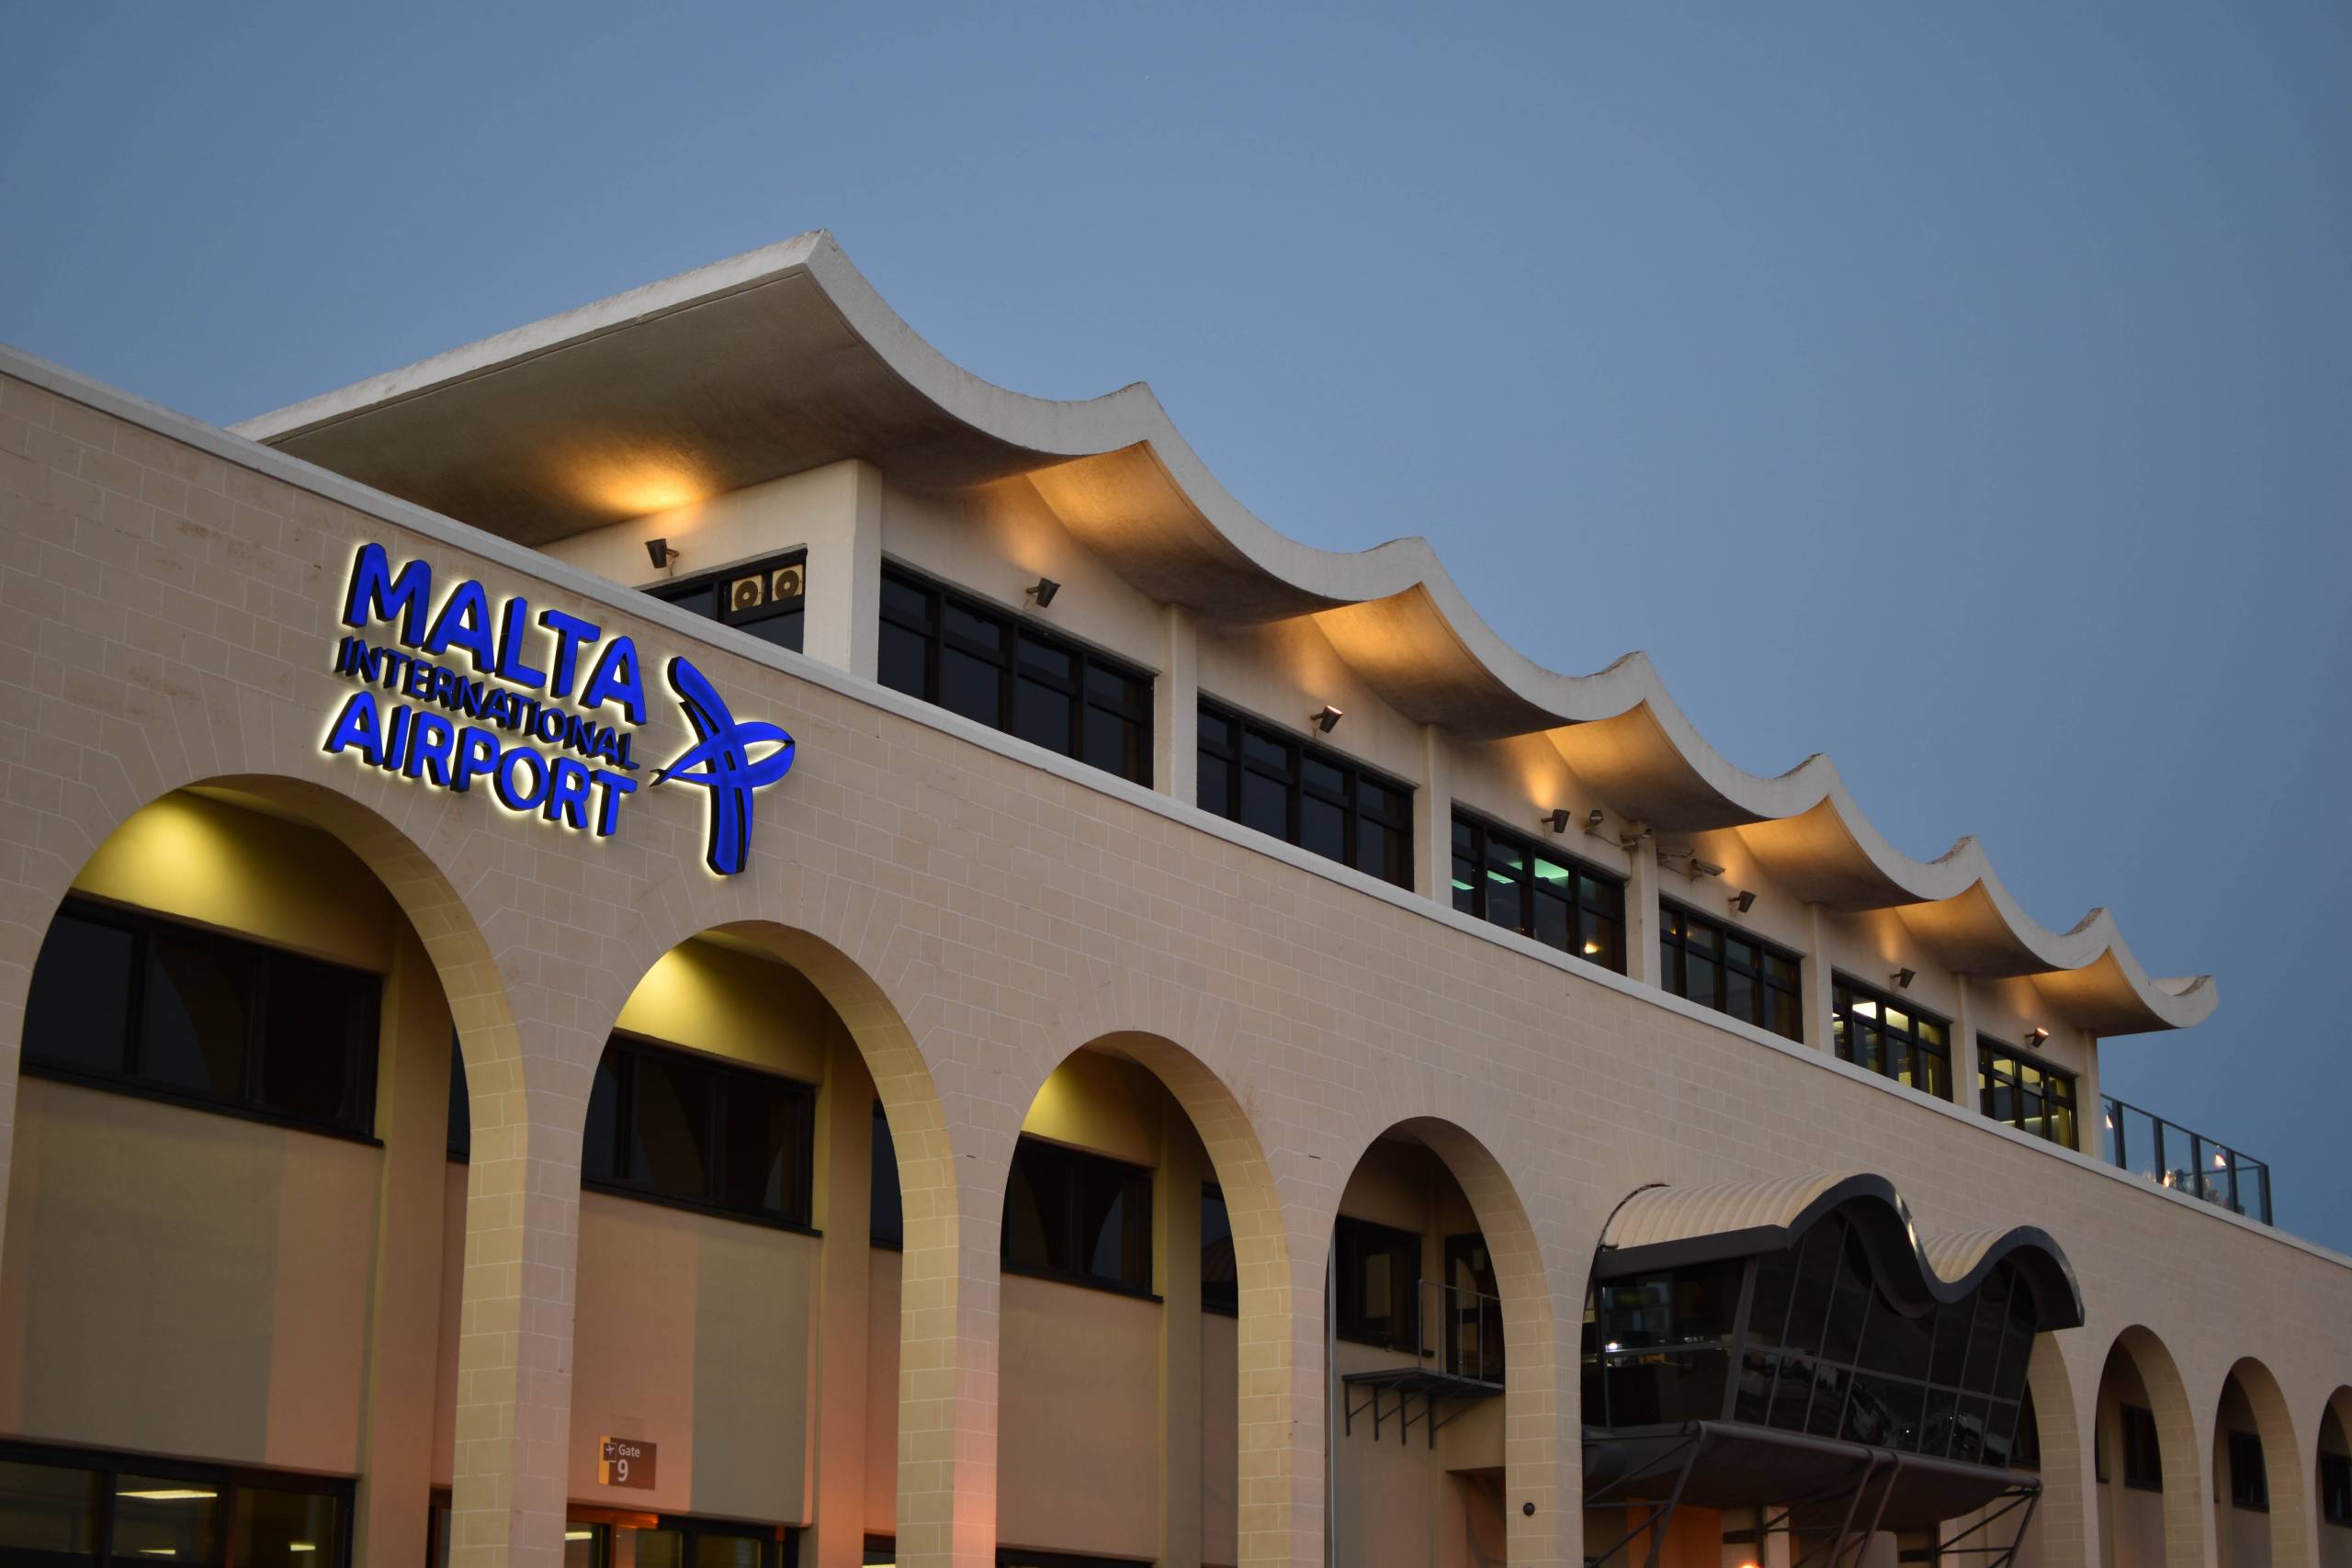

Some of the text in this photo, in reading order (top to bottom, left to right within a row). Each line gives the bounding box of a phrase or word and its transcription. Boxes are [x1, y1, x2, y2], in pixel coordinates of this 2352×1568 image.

[342, 542, 647, 726] MALTA
[322, 691, 639, 838] AIRPORT
[334, 635, 640, 771] INTERNATIONAL
[616, 1459, 629, 1483] 9
[617, 1444, 640, 1458] Gate
